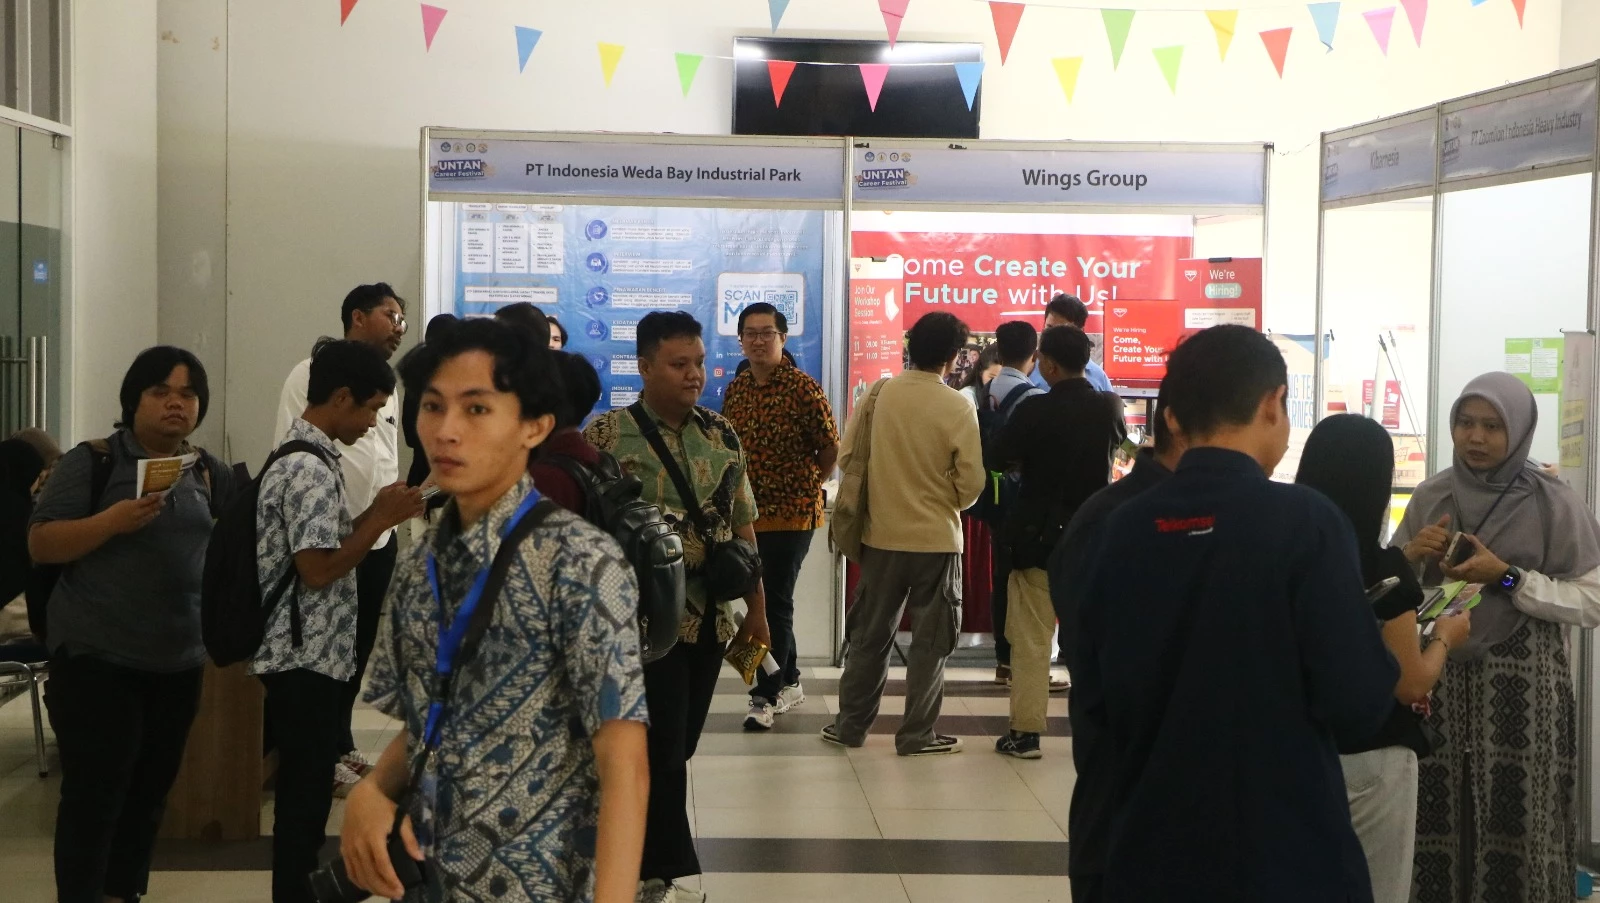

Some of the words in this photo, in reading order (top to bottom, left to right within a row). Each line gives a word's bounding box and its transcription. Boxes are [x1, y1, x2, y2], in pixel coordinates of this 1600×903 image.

[1505, 119, 1534, 140] Indonesia
[1535, 116, 1554, 136] Heavy
[1555, 110, 1584, 130] Industry
[438, 160, 481, 171] UNTAN
[526, 163, 544, 176] PT
[547, 164, 619, 178] Indonesia
[622, 166, 663, 179] Weda
[666, 166, 693, 182] Bay
[697, 167, 765, 181] Industrial
[769, 168, 801, 182] Park
[862, 170, 904, 180] UNTAN
[1022, 168, 1082, 191] Wings
[1086, 169, 1148, 191] Group
[974, 255, 1067, 278] Create
[1076, 256, 1142, 279] Your
[1210, 269, 1236, 280] We're
[854, 284, 865, 295] Join
[905, 282, 999, 305] Future
[1210, 284, 1238, 297] Hiring!
[724, 290, 760, 301] SCAN
[854, 296, 880, 307] Workshop
[1113, 336, 1141, 344] Come,
[1113, 345, 1142, 354] Create
[1113, 354, 1142, 363] Future
[1144, 354, 1163, 363] with
